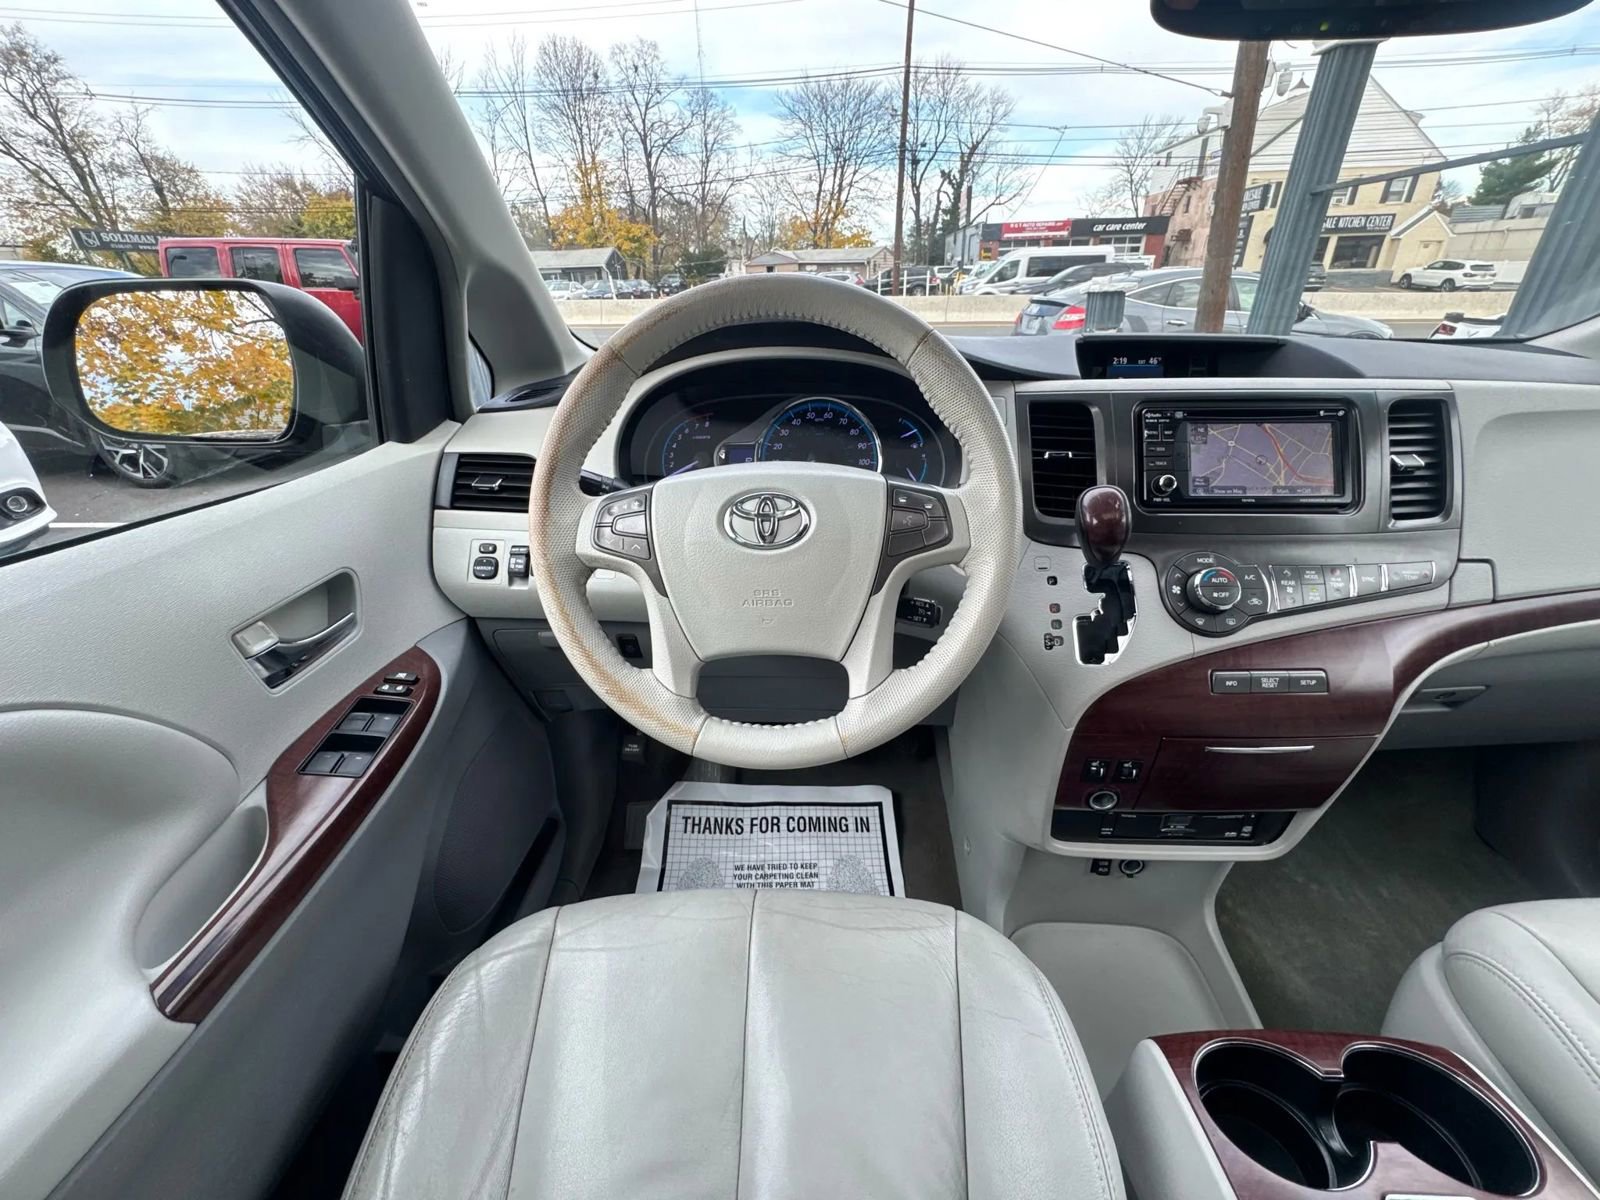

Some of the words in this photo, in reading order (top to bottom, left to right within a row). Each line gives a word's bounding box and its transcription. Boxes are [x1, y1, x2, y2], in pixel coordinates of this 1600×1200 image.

[1338, 216, 1366, 228] KITCHEN
[1366, 215, 1393, 227] CENTER
[1093, 223, 1105, 232] car
[1105, 222, 1121, 231] care
[1122, 221, 1147, 231] center
[100, 232, 156, 244] SOLIMAN
[1113, 357, 1127, 365] 2:19
[791, 418, 801, 426] 40
[850, 428, 859, 436] 80
[858, 458, 870, 466] 100
[753, 589, 781, 597] SRS
[742, 598, 794, 608] AIRBAG
[681, 816, 744, 835] THANKS
[749, 816, 780, 834] FOR
[786, 816, 849, 833] COMING
[854, 816, 870, 833] IN
[767, 863, 788, 871] TRIED
[733, 873, 753, 881] YOUR
